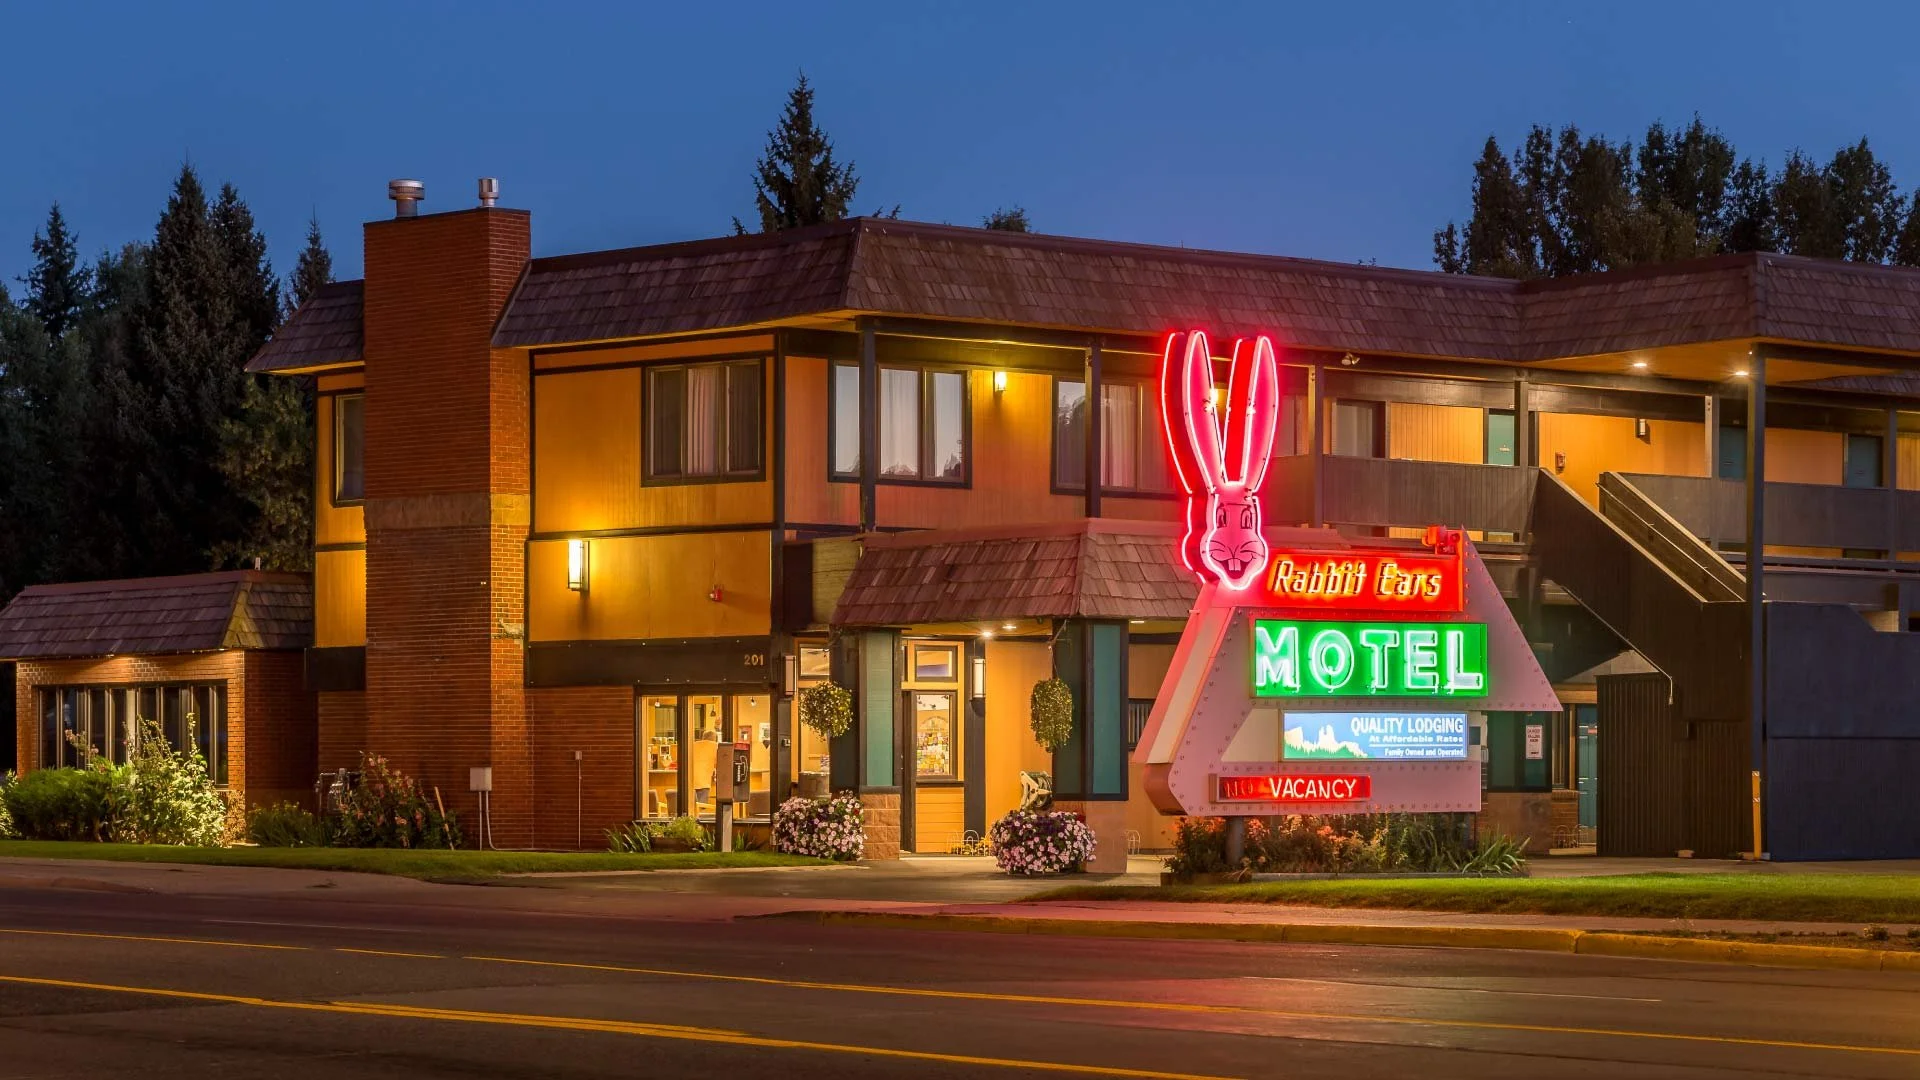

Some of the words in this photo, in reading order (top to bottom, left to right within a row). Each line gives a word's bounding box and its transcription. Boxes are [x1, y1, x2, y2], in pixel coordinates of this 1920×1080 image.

[1272, 560, 1367, 594] Rabbit
[1376, 562, 1442, 597] Ears
[744, 654, 764, 666] 201
[1255, 627, 1483, 690] MOTEL
[1350, 716, 1404, 736] QUALITY
[1407, 717, 1464, 734] LODGING
[1369, 735, 1380, 743] At
[1382, 735, 1434, 743] Affordable
[1436, 735, 1464, 743] Rates
[1384, 748, 1404, 757] Family
[1405, 748, 1424, 756] Owned
[1425, 748, 1436, 756] and
[1437, 748, 1464, 757] Operated
[1268, 777, 1357, 799] VACANCY
